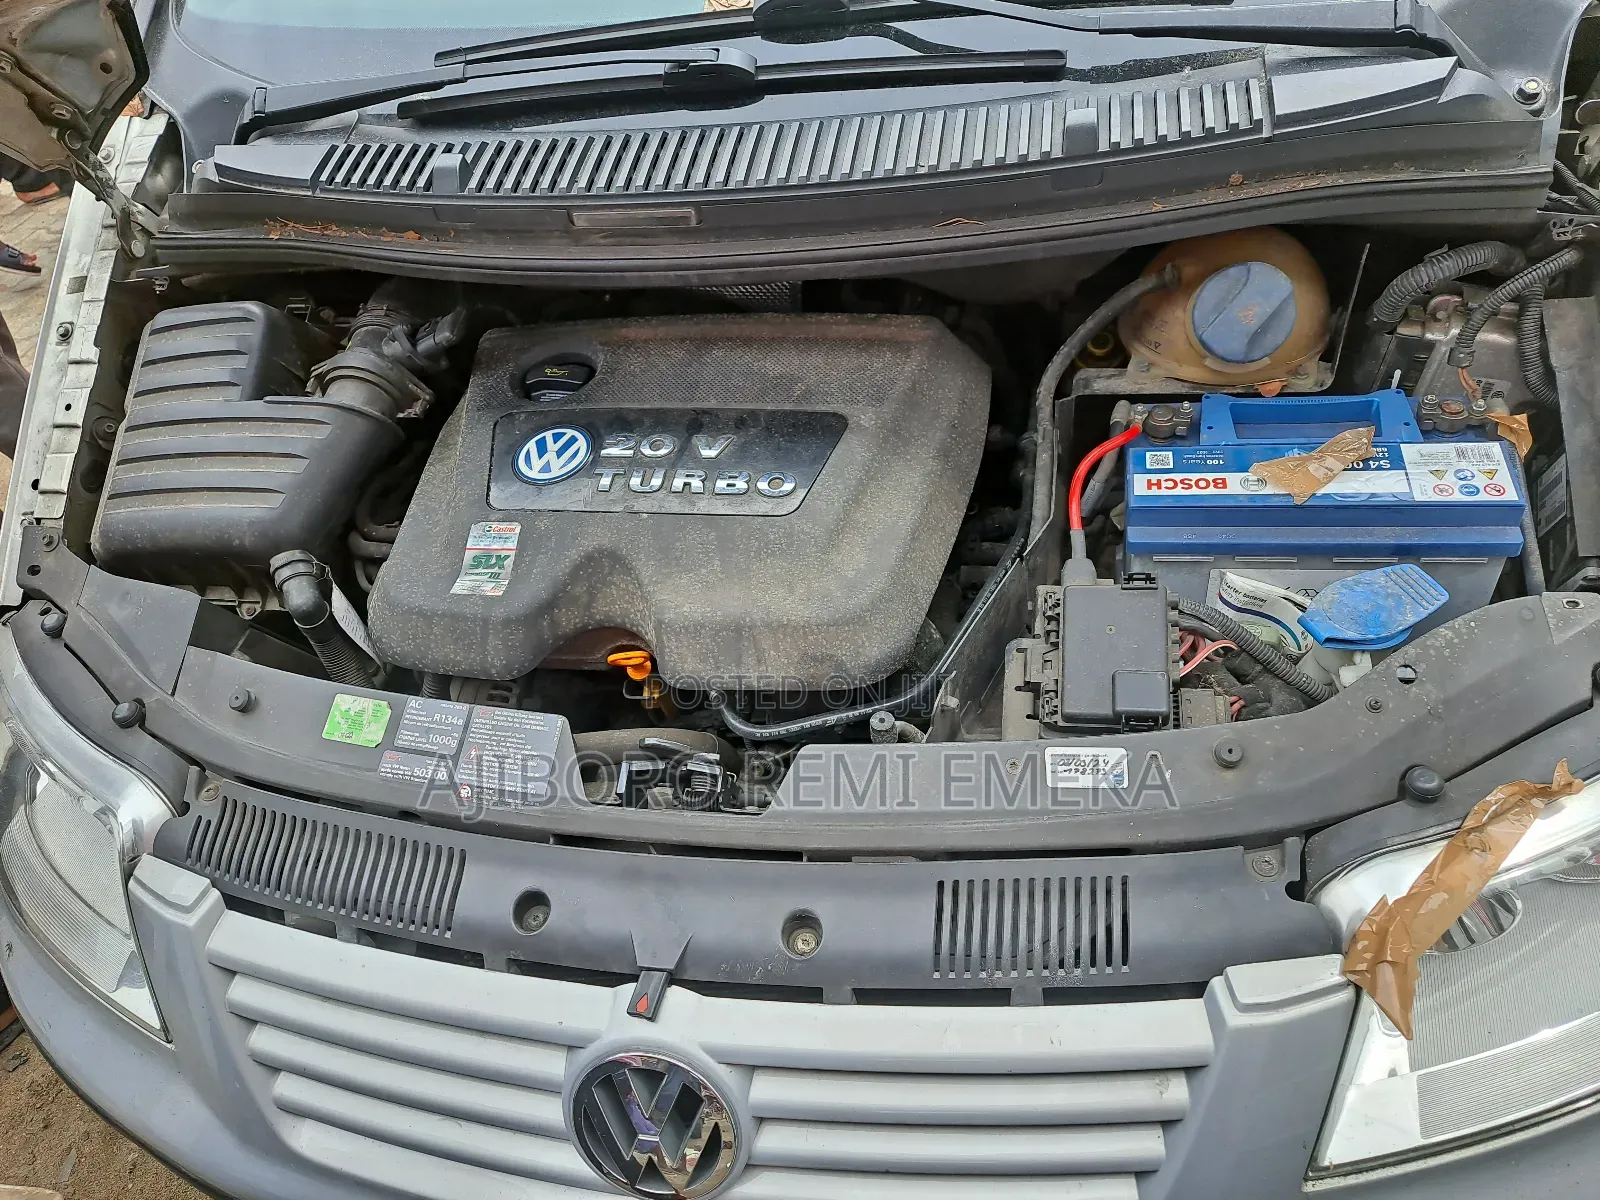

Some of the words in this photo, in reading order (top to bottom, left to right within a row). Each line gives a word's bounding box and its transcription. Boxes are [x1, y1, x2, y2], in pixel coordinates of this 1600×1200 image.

[1367, 459, 1391, 469] S4
[592, 466, 799, 499] TURBO
[1146, 477, 1228, 490] BOSCH
[492, 525, 517, 533] Castrol
[468, 553, 511, 570] SLX
[408, 699, 424, 709] AC
[432, 713, 464, 726] R134a
[427, 733, 458, 748] 1000g
[412, 767, 432, 778] 503
